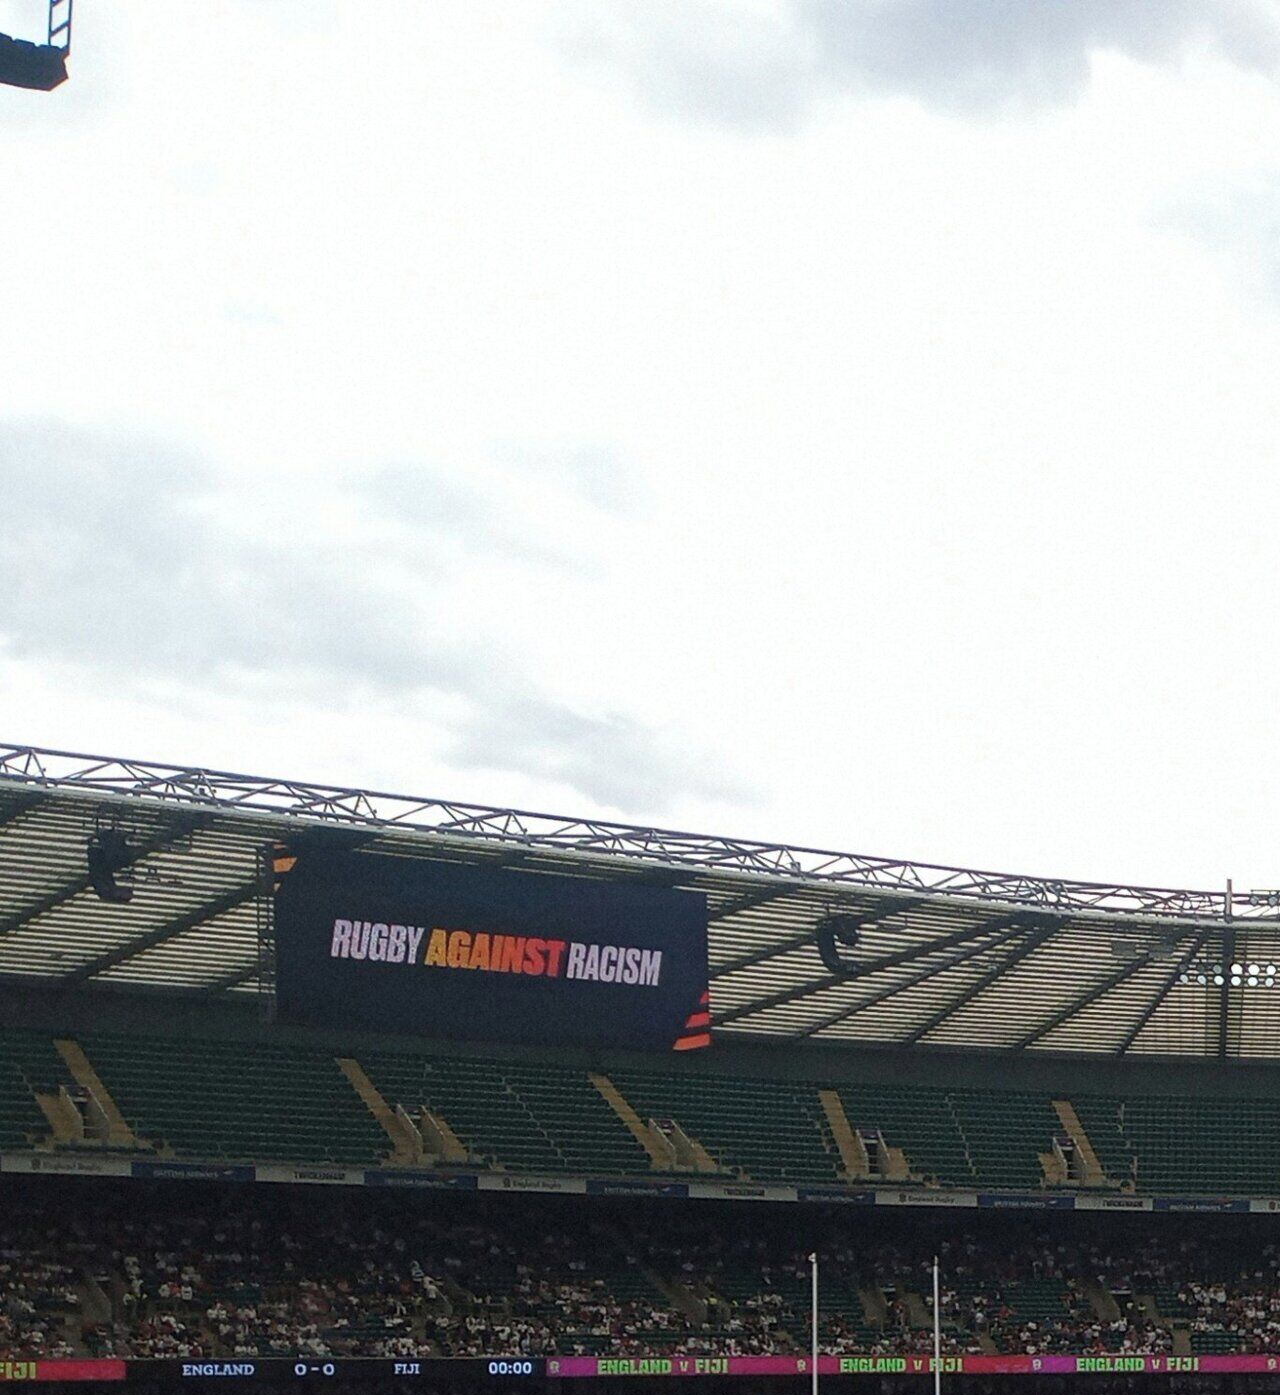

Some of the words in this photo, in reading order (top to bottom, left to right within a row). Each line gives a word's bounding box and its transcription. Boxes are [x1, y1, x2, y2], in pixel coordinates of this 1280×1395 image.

[331, 918, 425, 965] RUGBY
[424, 928, 565, 978] AGAINST
[567, 942, 663, 987] RACISM
[182, 1364, 255, 1376] ENGLAND
[394, 1363, 421, 1375] FIJI
[488, 1363, 532, 1375] 00:00
[597, 1358, 672, 1374] ENGLAND
[695, 1358, 728, 1374] FIJI
[840, 1358, 906, 1373] ENGLAND
[1076, 1358, 1145, 1372] ENGLAND
[1166, 1358, 1199, 1371] FIJI
